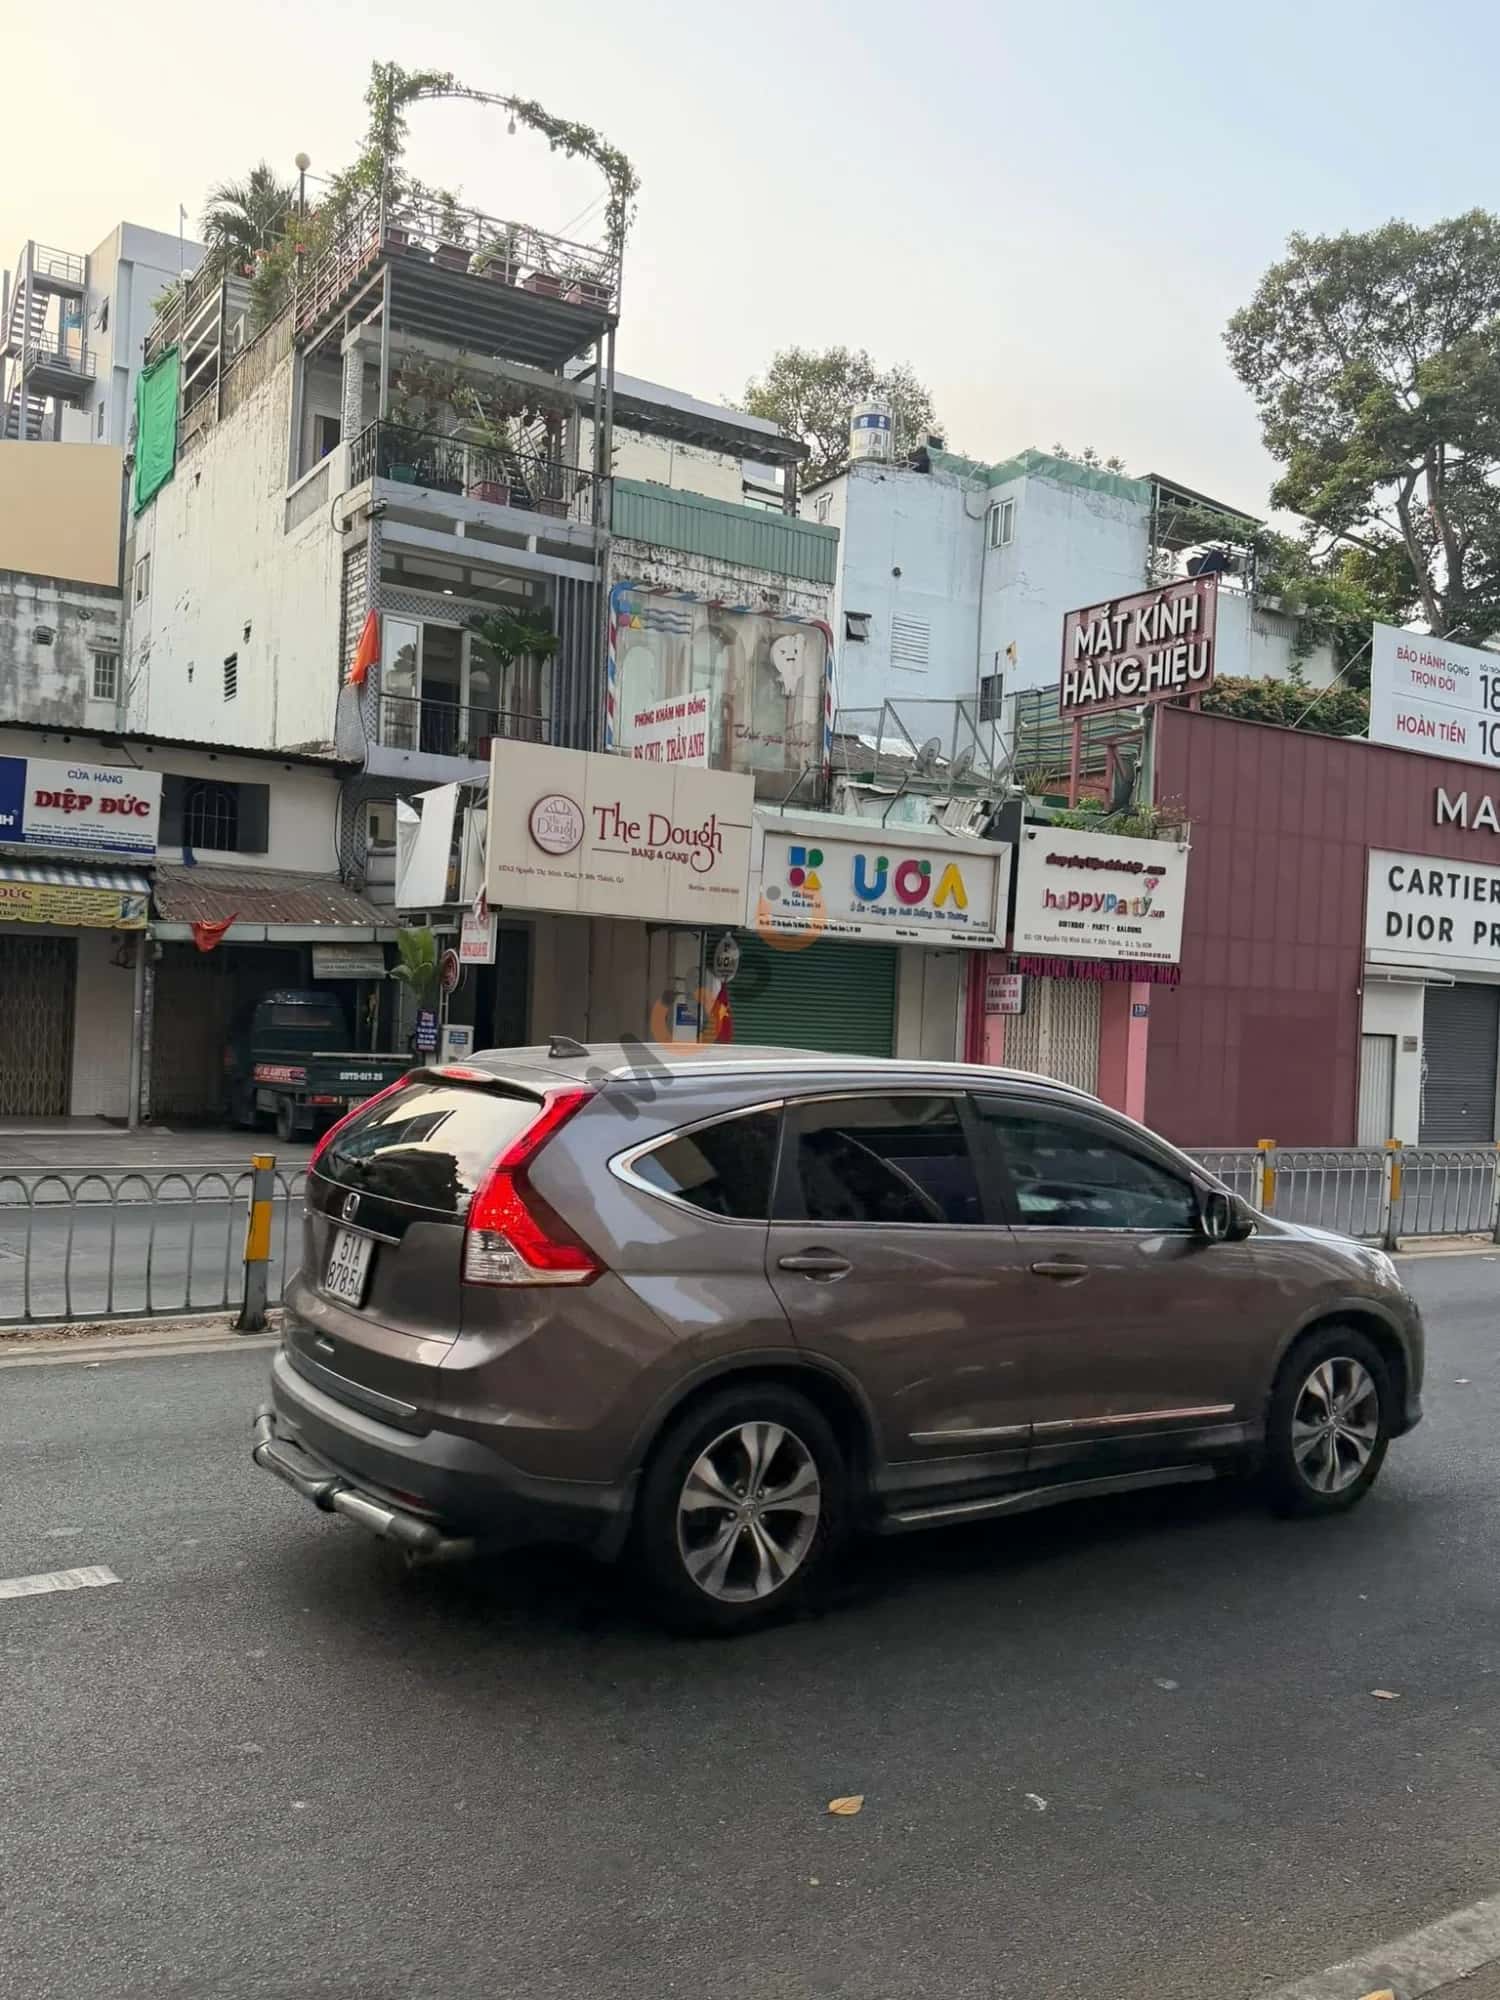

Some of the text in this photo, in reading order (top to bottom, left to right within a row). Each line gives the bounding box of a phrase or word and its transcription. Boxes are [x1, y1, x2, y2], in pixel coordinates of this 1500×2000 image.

[1074, 594, 1199, 659] MẮT KÍNH
[1396, 645, 1418, 663] BẢO
[1419, 651, 1446, 670] HÀNH
[1063, 638, 1207, 706] HÀNG HIỆU
[1411, 669, 1456, 692] TRỌN ĐỜI
[655, 704, 674, 723] KHÁM
[1396, 714, 1436, 737] HOÀN
[687, 732, 705, 758] ANH
[67, 768, 123, 784] CỬA HÀNG
[34, 788, 151, 816] DIỆP ĐỨC
[592, 802, 722, 873] The Dough
[1386, 911, 1454, 942] DIOR
